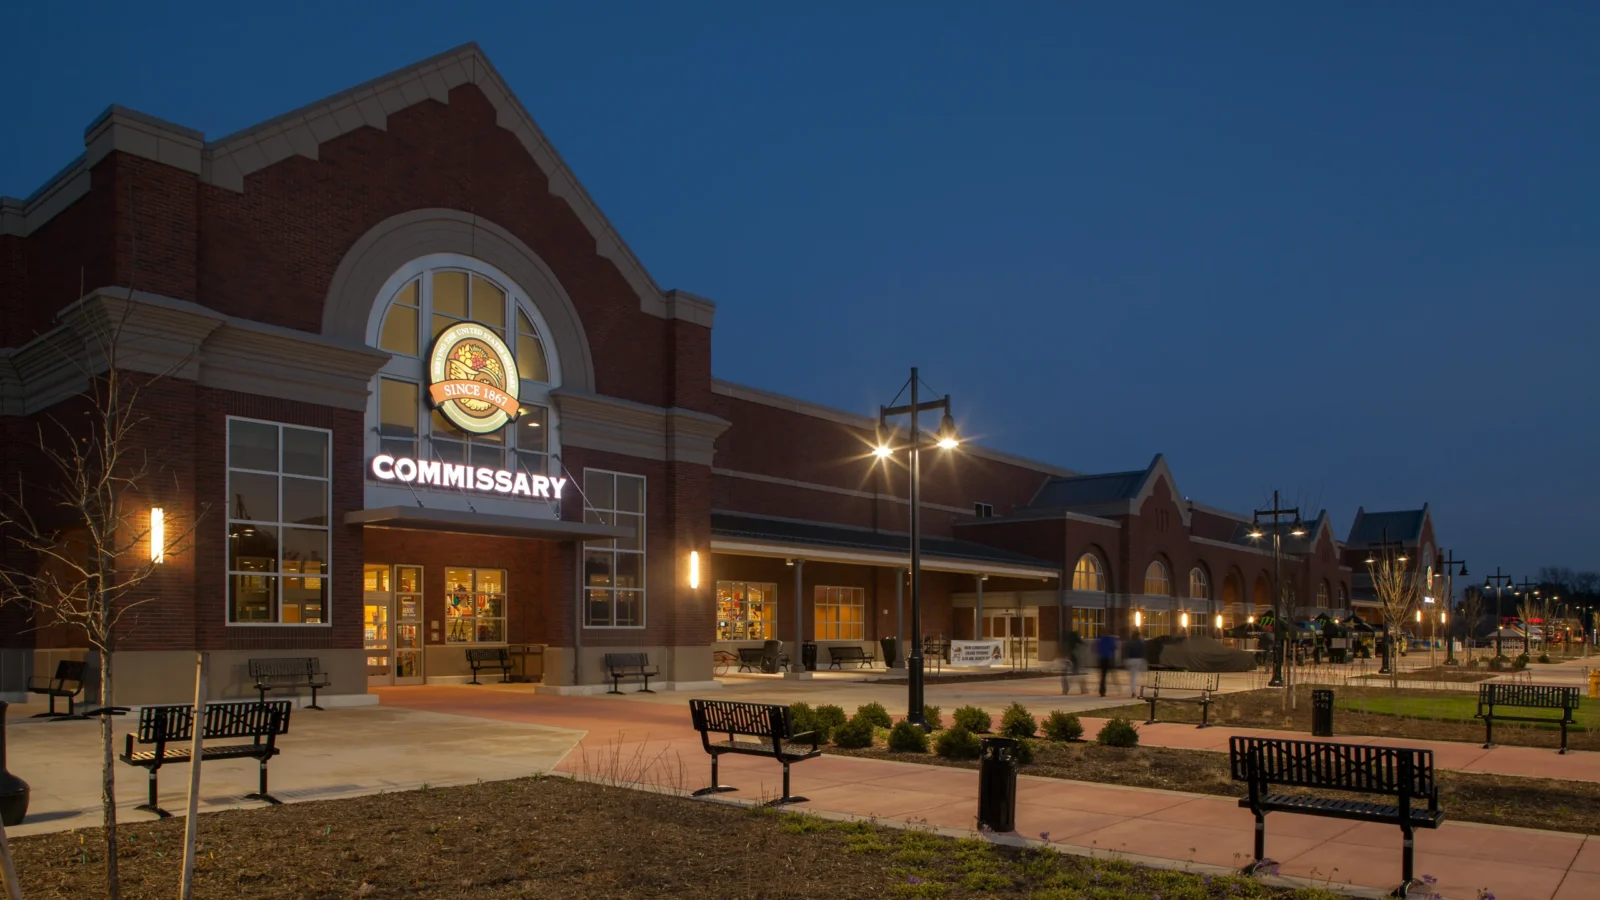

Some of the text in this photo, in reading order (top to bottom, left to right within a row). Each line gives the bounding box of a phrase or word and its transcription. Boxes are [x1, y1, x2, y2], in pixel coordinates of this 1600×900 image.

[444, 332, 457, 344] THE
[456, 327, 483, 336] UNITED
[483, 332, 505, 354] STATES
[443, 383, 508, 407] SINCE 1867
[372, 454, 567, 499] COMMISSARY
